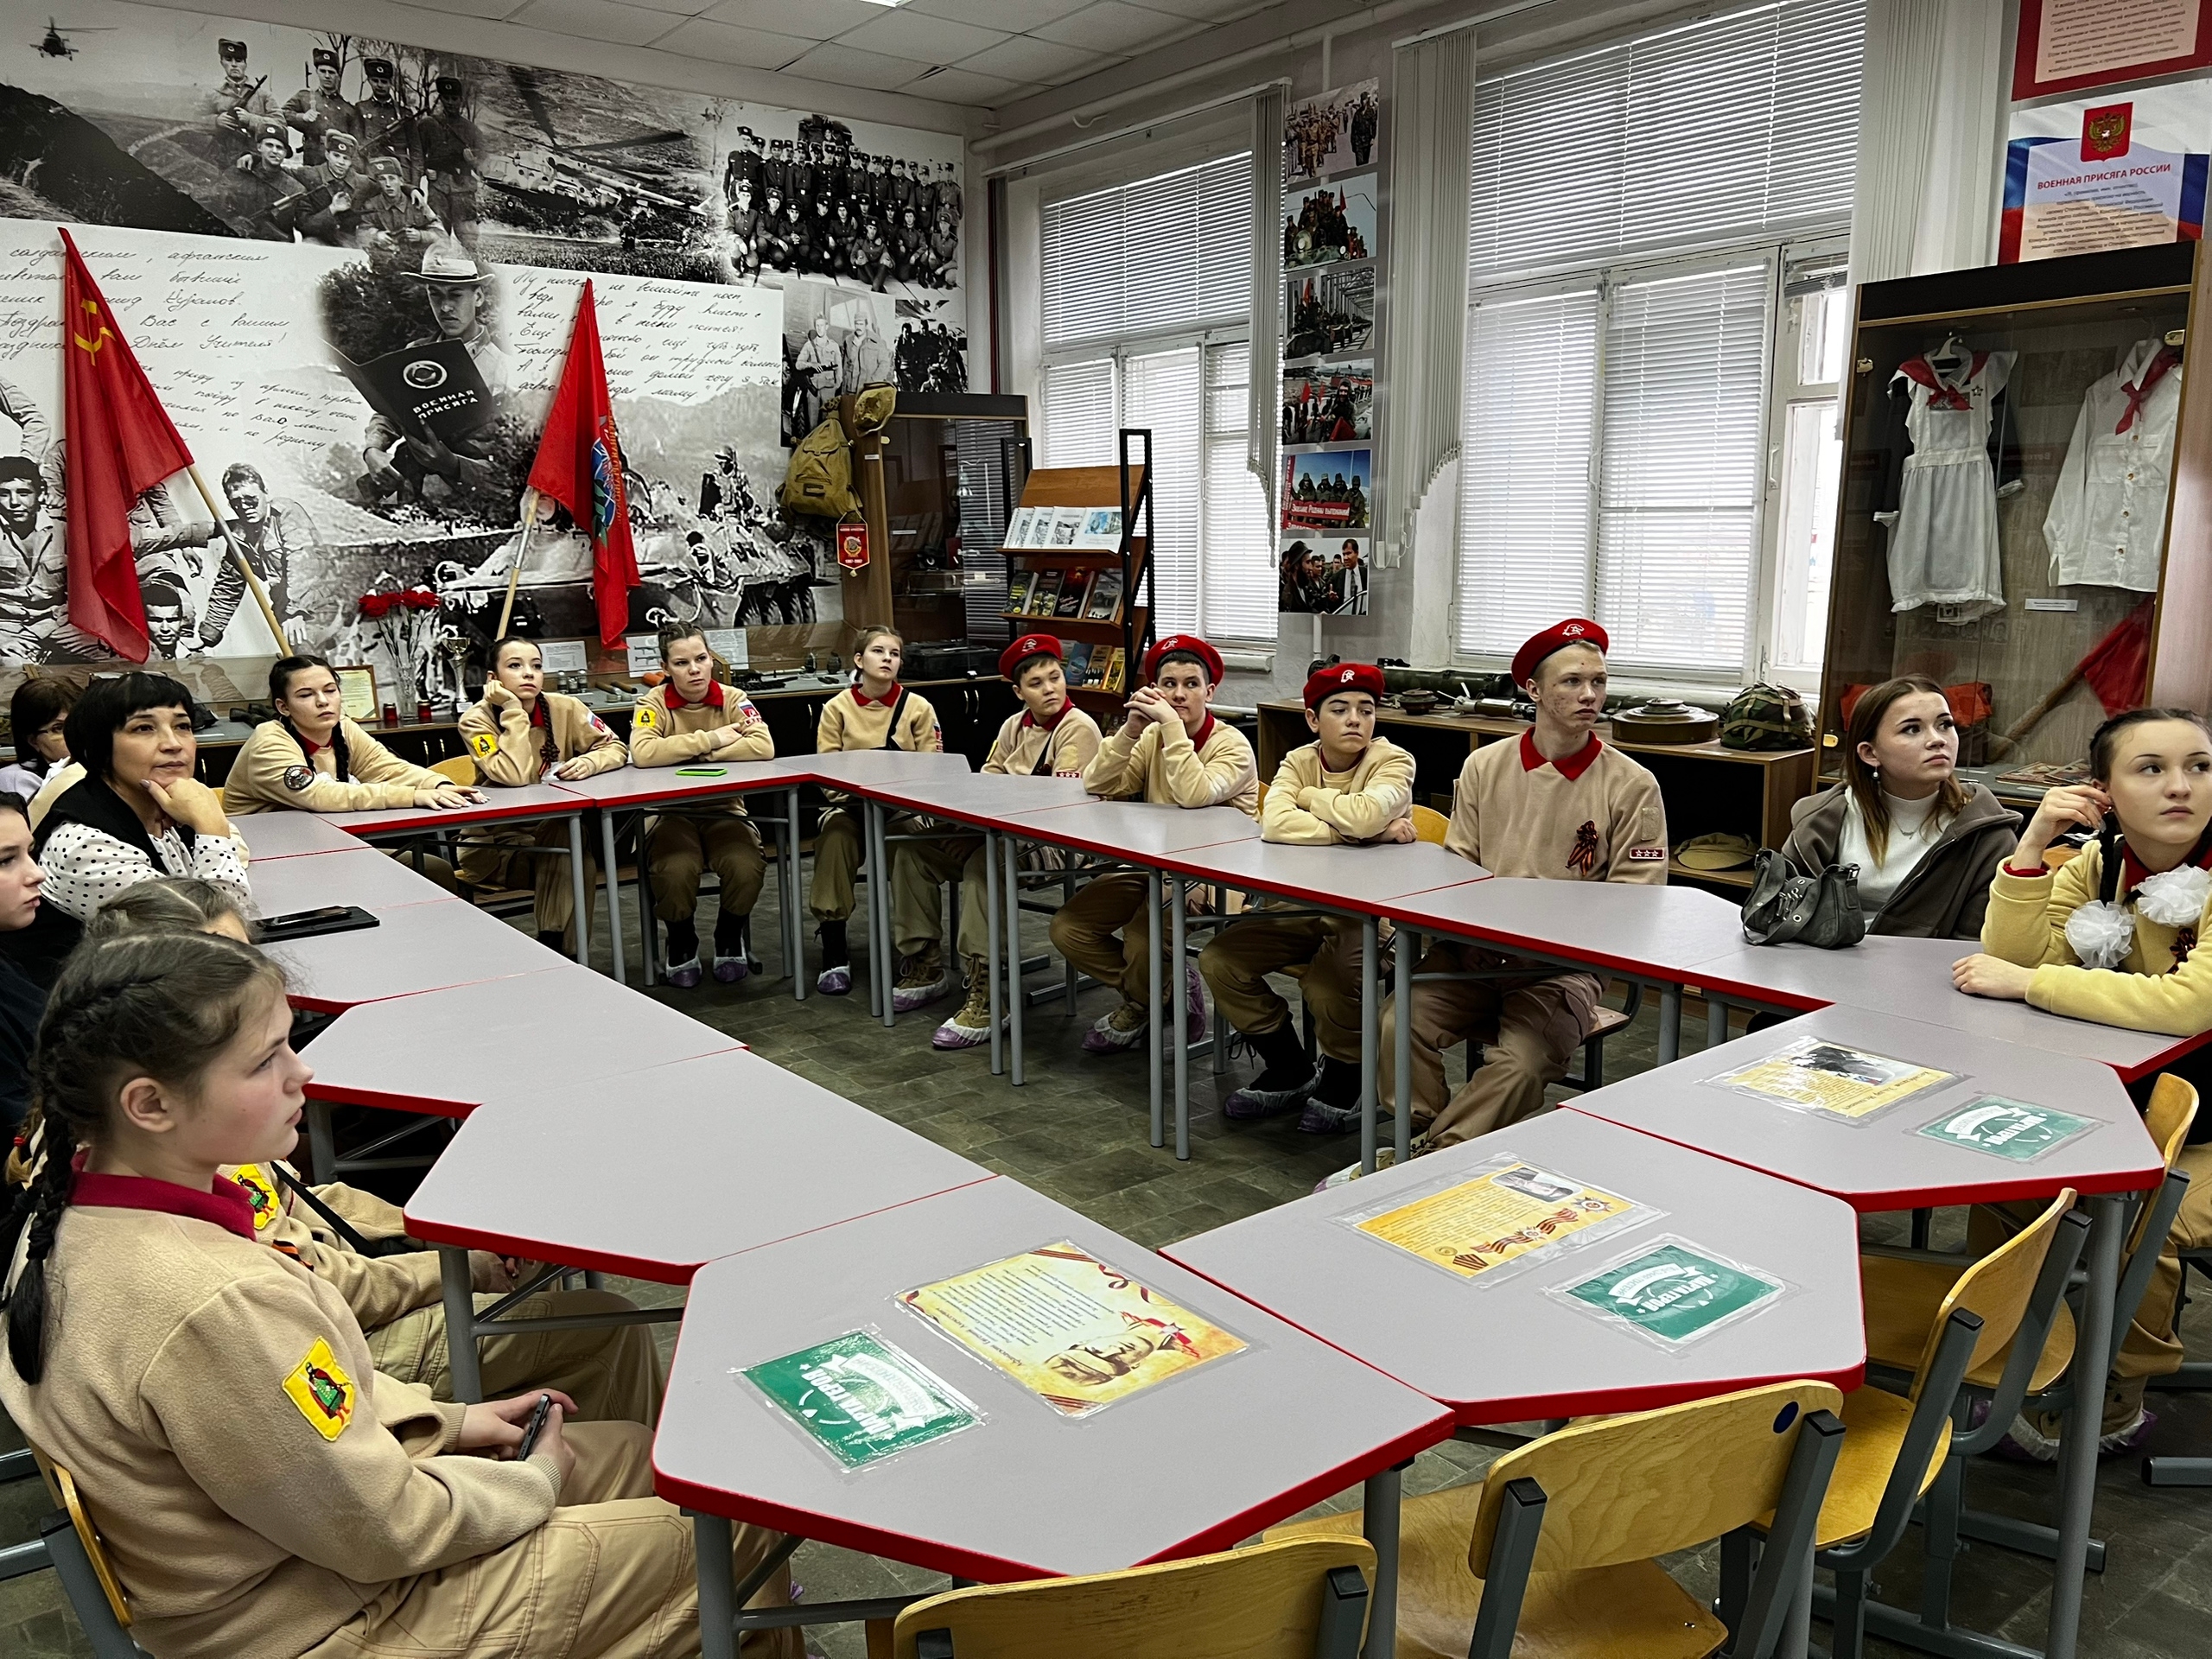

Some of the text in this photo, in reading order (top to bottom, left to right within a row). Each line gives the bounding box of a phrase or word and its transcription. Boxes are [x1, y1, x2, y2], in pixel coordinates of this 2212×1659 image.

[2037, 163, 2171, 189] ВОЕННАЯ ПРИСЯГА РОССИИ
[412, 389, 474, 414] ВОЕННАЯ
[417, 397, 479, 420] ПРИСЯГА
[1673, 1274, 1716, 1294] ПАРТА
[1640, 1290, 1682, 1312] ГЕРОЯ
[801, 1368, 852, 1403] ГЕРОЯ
[837, 1397, 892, 1434] ПАРТА
